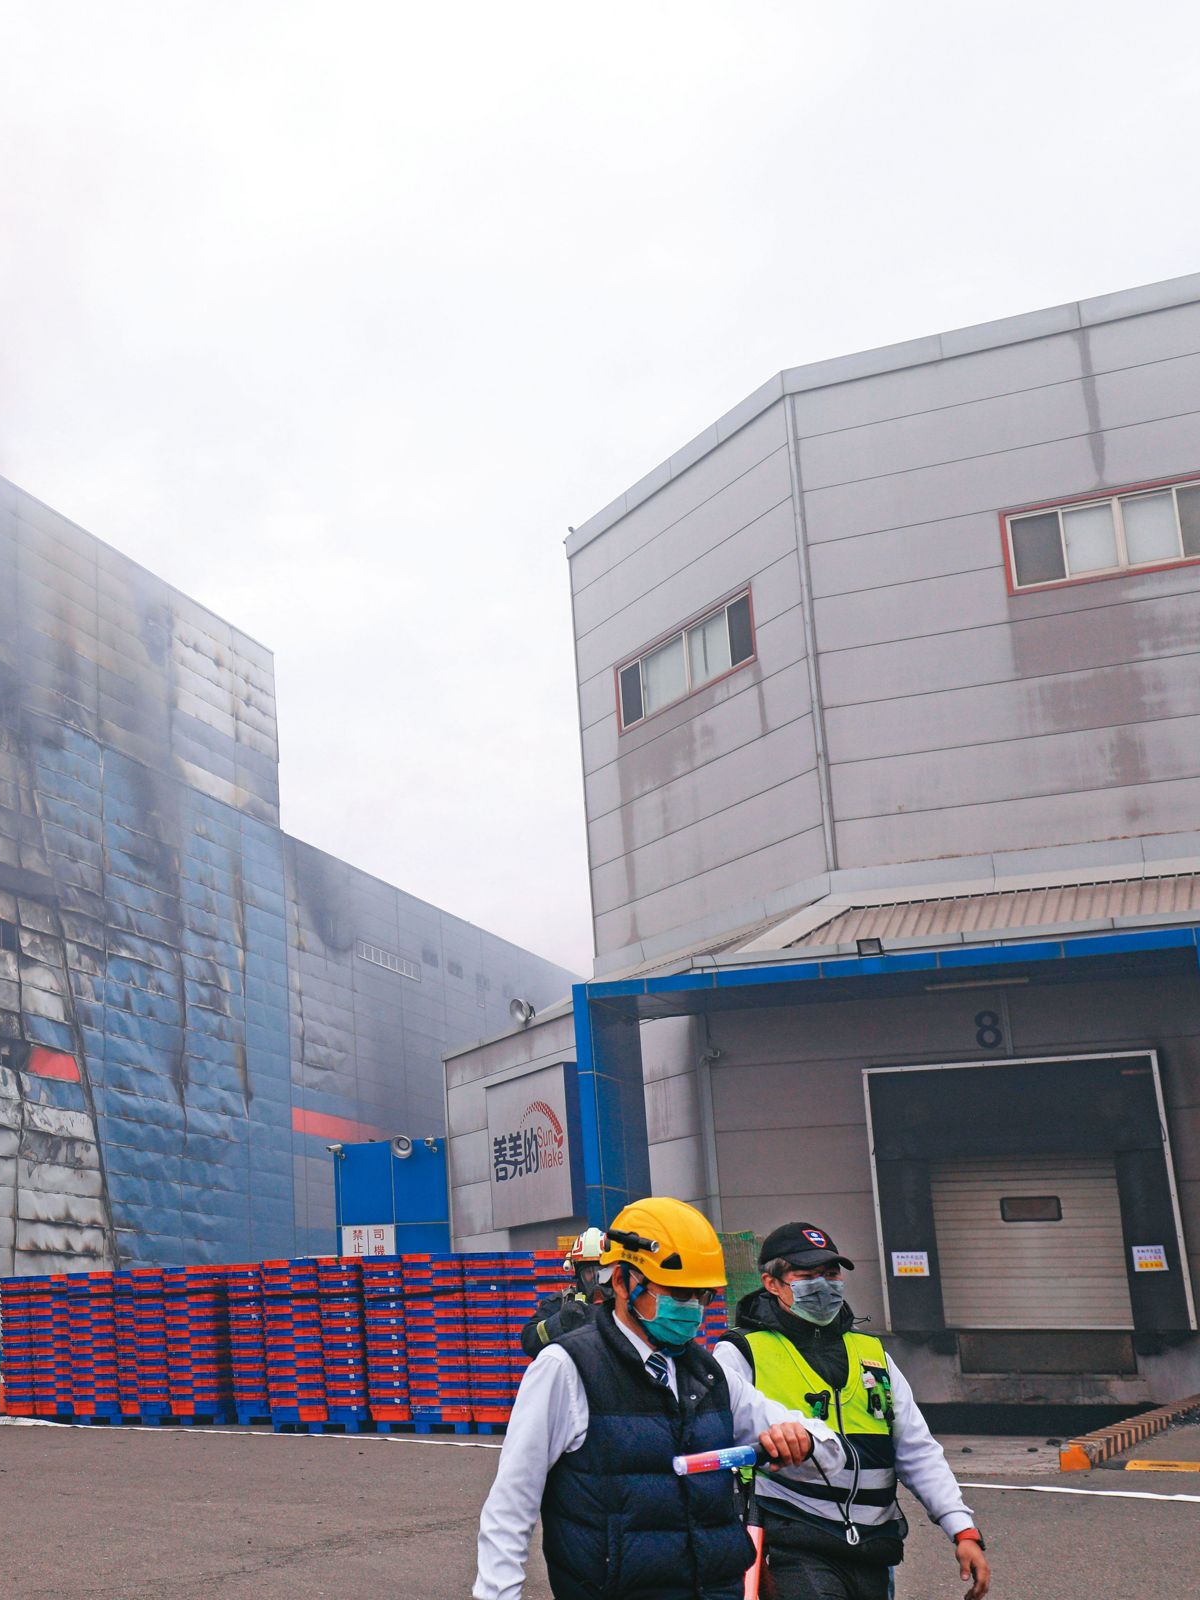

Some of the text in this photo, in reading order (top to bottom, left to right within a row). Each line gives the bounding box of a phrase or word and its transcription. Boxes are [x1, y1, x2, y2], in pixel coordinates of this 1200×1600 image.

[974, 1010, 1003, 1049] 8
[536, 1126, 554, 1149] Sun
[493, 1127, 540, 1182] 善美的
[540, 1148, 564, 1170] Make
[352, 1229, 365, 1254] 禁止
